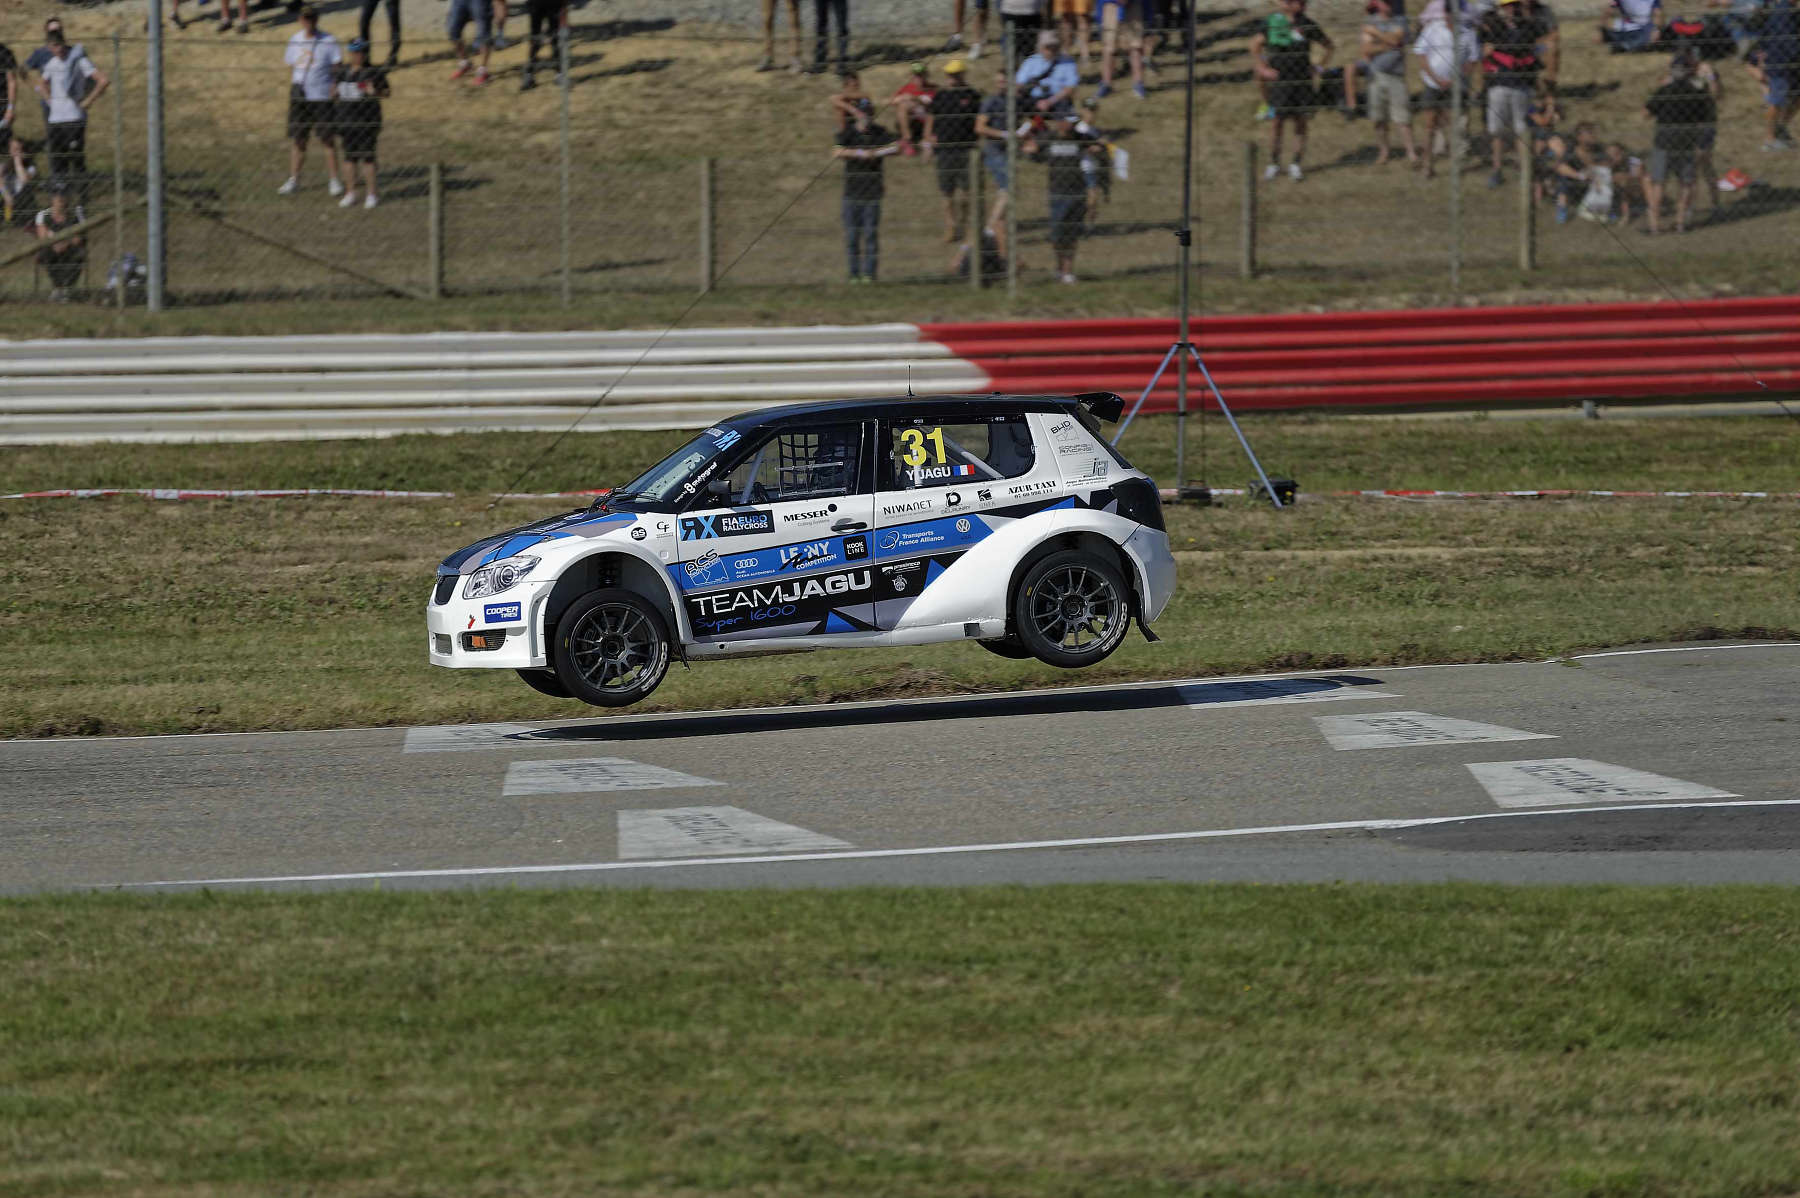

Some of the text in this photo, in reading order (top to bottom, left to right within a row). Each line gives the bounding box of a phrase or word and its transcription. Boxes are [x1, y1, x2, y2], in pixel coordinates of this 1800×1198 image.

[901, 427, 947, 466] 31
[919, 466, 951, 480] JAGU
[1008, 483, 1033, 494] AZUR
[1033, 480, 1057, 490] TAXI
[783, 510, 829, 522] MESSER
[722, 521, 768, 532] RALLYCROSS
[632, 529, 646, 537] as
[902, 530, 934, 539] Transports
[899, 538, 919, 547] France
[796, 554, 837, 570] COMPETITION
[486, 606, 519, 615] COOPER
